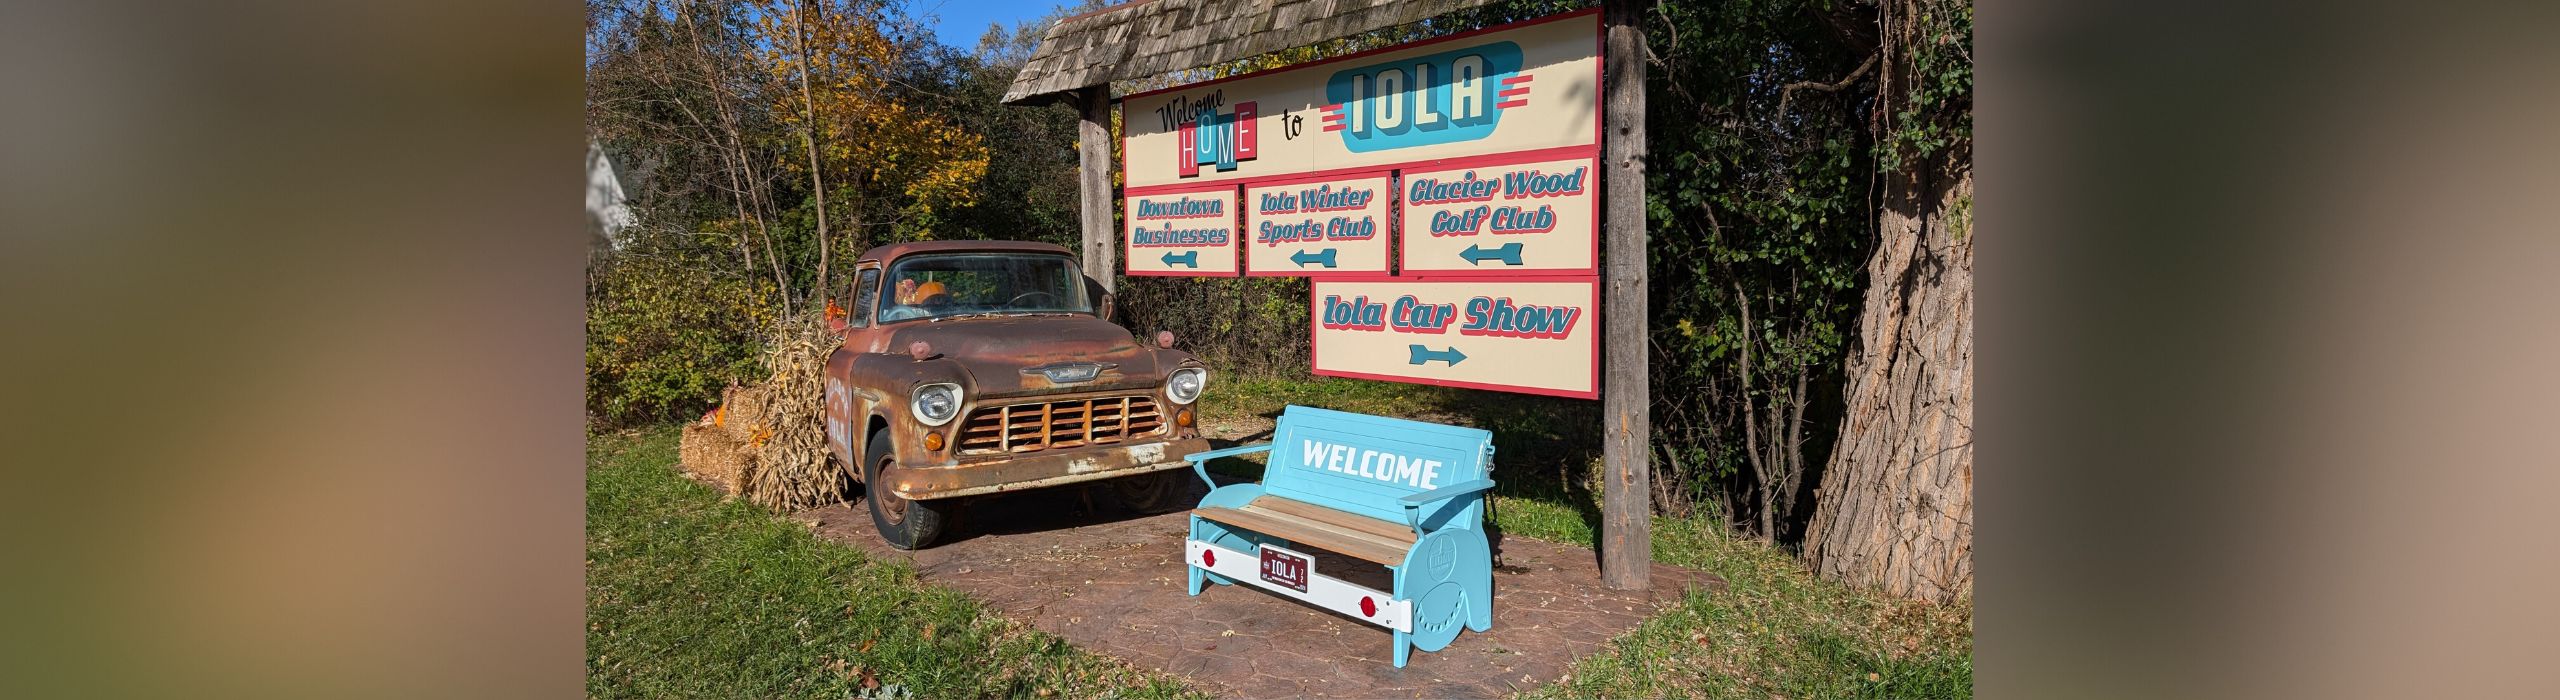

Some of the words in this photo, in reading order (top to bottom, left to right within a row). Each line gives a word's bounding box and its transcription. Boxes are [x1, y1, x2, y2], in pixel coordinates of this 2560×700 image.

[1156, 89, 1225, 132] Welcome
[1182, 111, 1250, 169] HOME
[1282, 108, 1303, 141] to
[1352, 54, 1490, 137] IOLA
[1260, 191, 1297, 215] Iola
[1301, 184, 1373, 213] Winter
[1409, 170, 1502, 206] Glacier
[1504, 166, 1588, 199] Wood
[1137, 197, 1223, 220] Downtown
[1430, 205, 1491, 237] Golf
[1489, 204, 1557, 235] Club
[1132, 222, 1229, 247] Businesses
[1257, 219, 1324, 247] Sports
[1327, 215, 1376, 241] Club
[1322, 294, 1387, 332] Iola
[1390, 294, 1457, 335] Car
[1460, 296, 1581, 340] Show
[1303, 439, 1442, 490] WELCOME
[1271, 559, 1297, 581] IOLA
